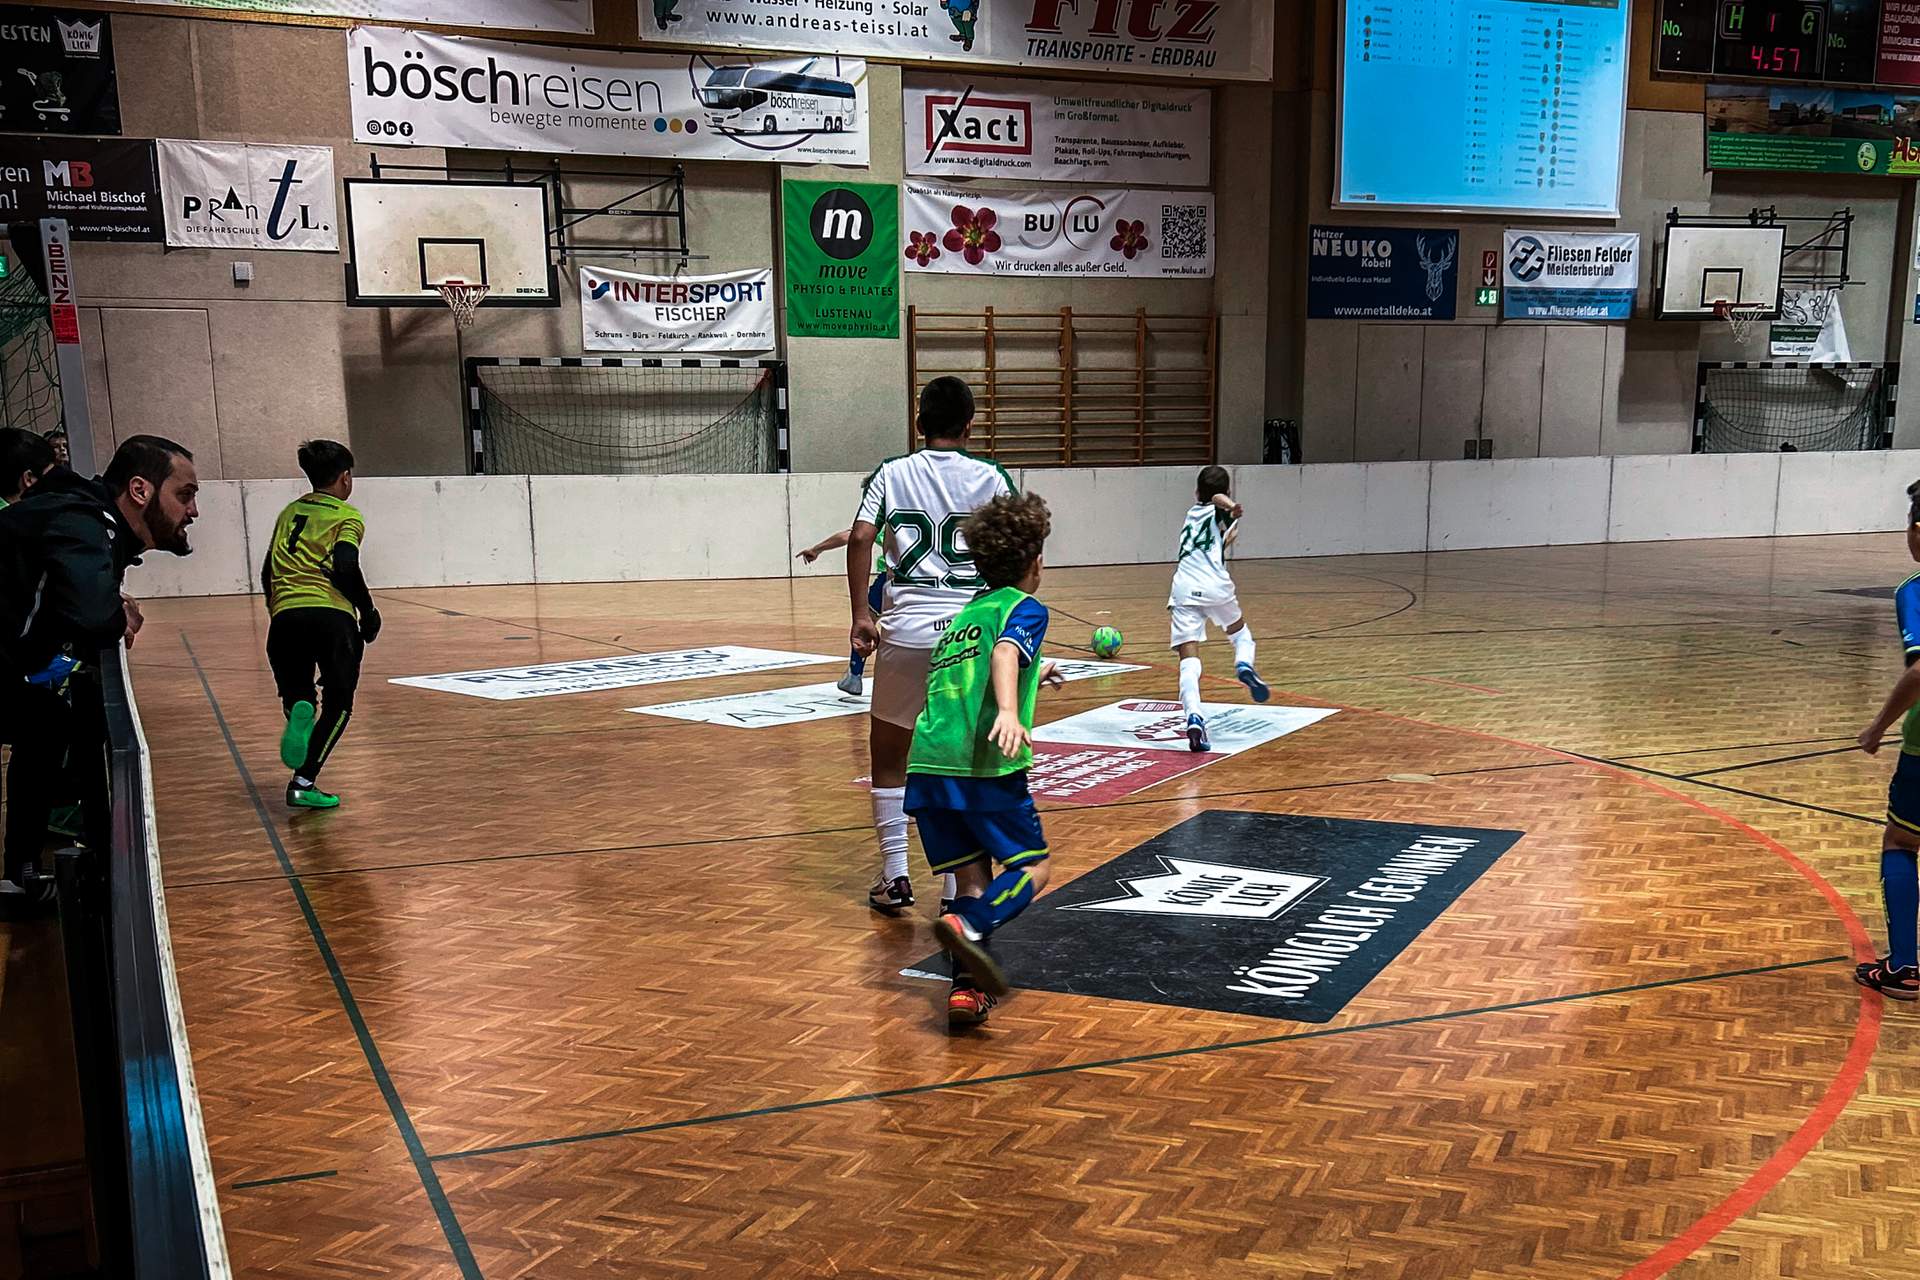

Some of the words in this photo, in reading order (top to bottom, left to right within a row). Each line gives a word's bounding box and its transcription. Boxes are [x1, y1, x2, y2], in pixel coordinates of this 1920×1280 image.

[815, 0, 873, 15] Heizung
[892, 1, 928, 16] Solar
[706, 10, 929, 37] www.andreas-teissl.at
[1729, 5, 1744, 29] H
[1801, 11, 1815, 34] G
[1663, 19, 1683, 37] No.
[1883, 24, 1900, 34] UND
[72, 41, 91, 50] LICH
[1828, 33, 1847, 49] No.
[1027, 39, 1135, 62] TRANSPORTE
[1151, 46, 1217, 68] ERDBAU
[363, 46, 663, 113] böschreisen
[1054, 96, 1140, 110] Umweltfreundlicher
[1142, 100, 1193, 113] Digitaldruck
[490, 108, 562, 130] bewegte
[568, 114, 647, 130] momente
[934, 156, 1032, 168] www.xact-digitaldruck.com
[46, 190, 97, 203] Michael
[100, 191, 147, 204] Bischof
[79, 225, 151, 233] www.mb-bischof.at
[186, 225, 201, 233] DIE
[203, 226, 260, 235] FAHRSCHULE
[822, 208, 862, 240] m
[1024, 213, 1055, 232] BU
[1073, 215, 1100, 233] LU
[1312, 229, 1344, 239] Netzer
[1312, 239, 1392, 258] NEUKO
[1547, 245, 1592, 262] Fliesen
[1594, 246, 1633, 263] Felder
[995, 260, 1012, 271] Wir
[1013, 261, 1051, 272] drucken
[1053, 261, 1074, 273] alles
[1075, 262, 1101, 273] außer
[1103, 262, 1127, 273] Geld.
[1161, 266, 1207, 275] www.bulu.at
[1361, 257, 1392, 268] Kobelt
[1546, 263, 1615, 277] Meisterbetrieb
[48, 243, 71, 303] BENZ
[819, 264, 868, 280] move
[613, 280, 766, 304] INTERSPORT
[793, 284, 835, 295] PHYSIO
[850, 285, 894, 296] PILATES
[654, 306, 726, 322] FISCHER
[815, 308, 872, 319] LUSTENAU
[1333, 305, 1433, 317] www.metalldeko.at
[595, 330, 623, 339] Schruns
[658, 332, 689, 340] Feldkirch
[736, 331, 766, 339] Dornbirn
[886, 508, 988, 590] 29
[452, 651, 731, 684] PLAMECO
[1158, 874, 1243, 906] KÖNIG
[1219, 882, 1291, 907] LICH
[1226, 904, 1397, 998] KÖNIGLICH
[1347, 834, 1480, 903] GEWINNEN
